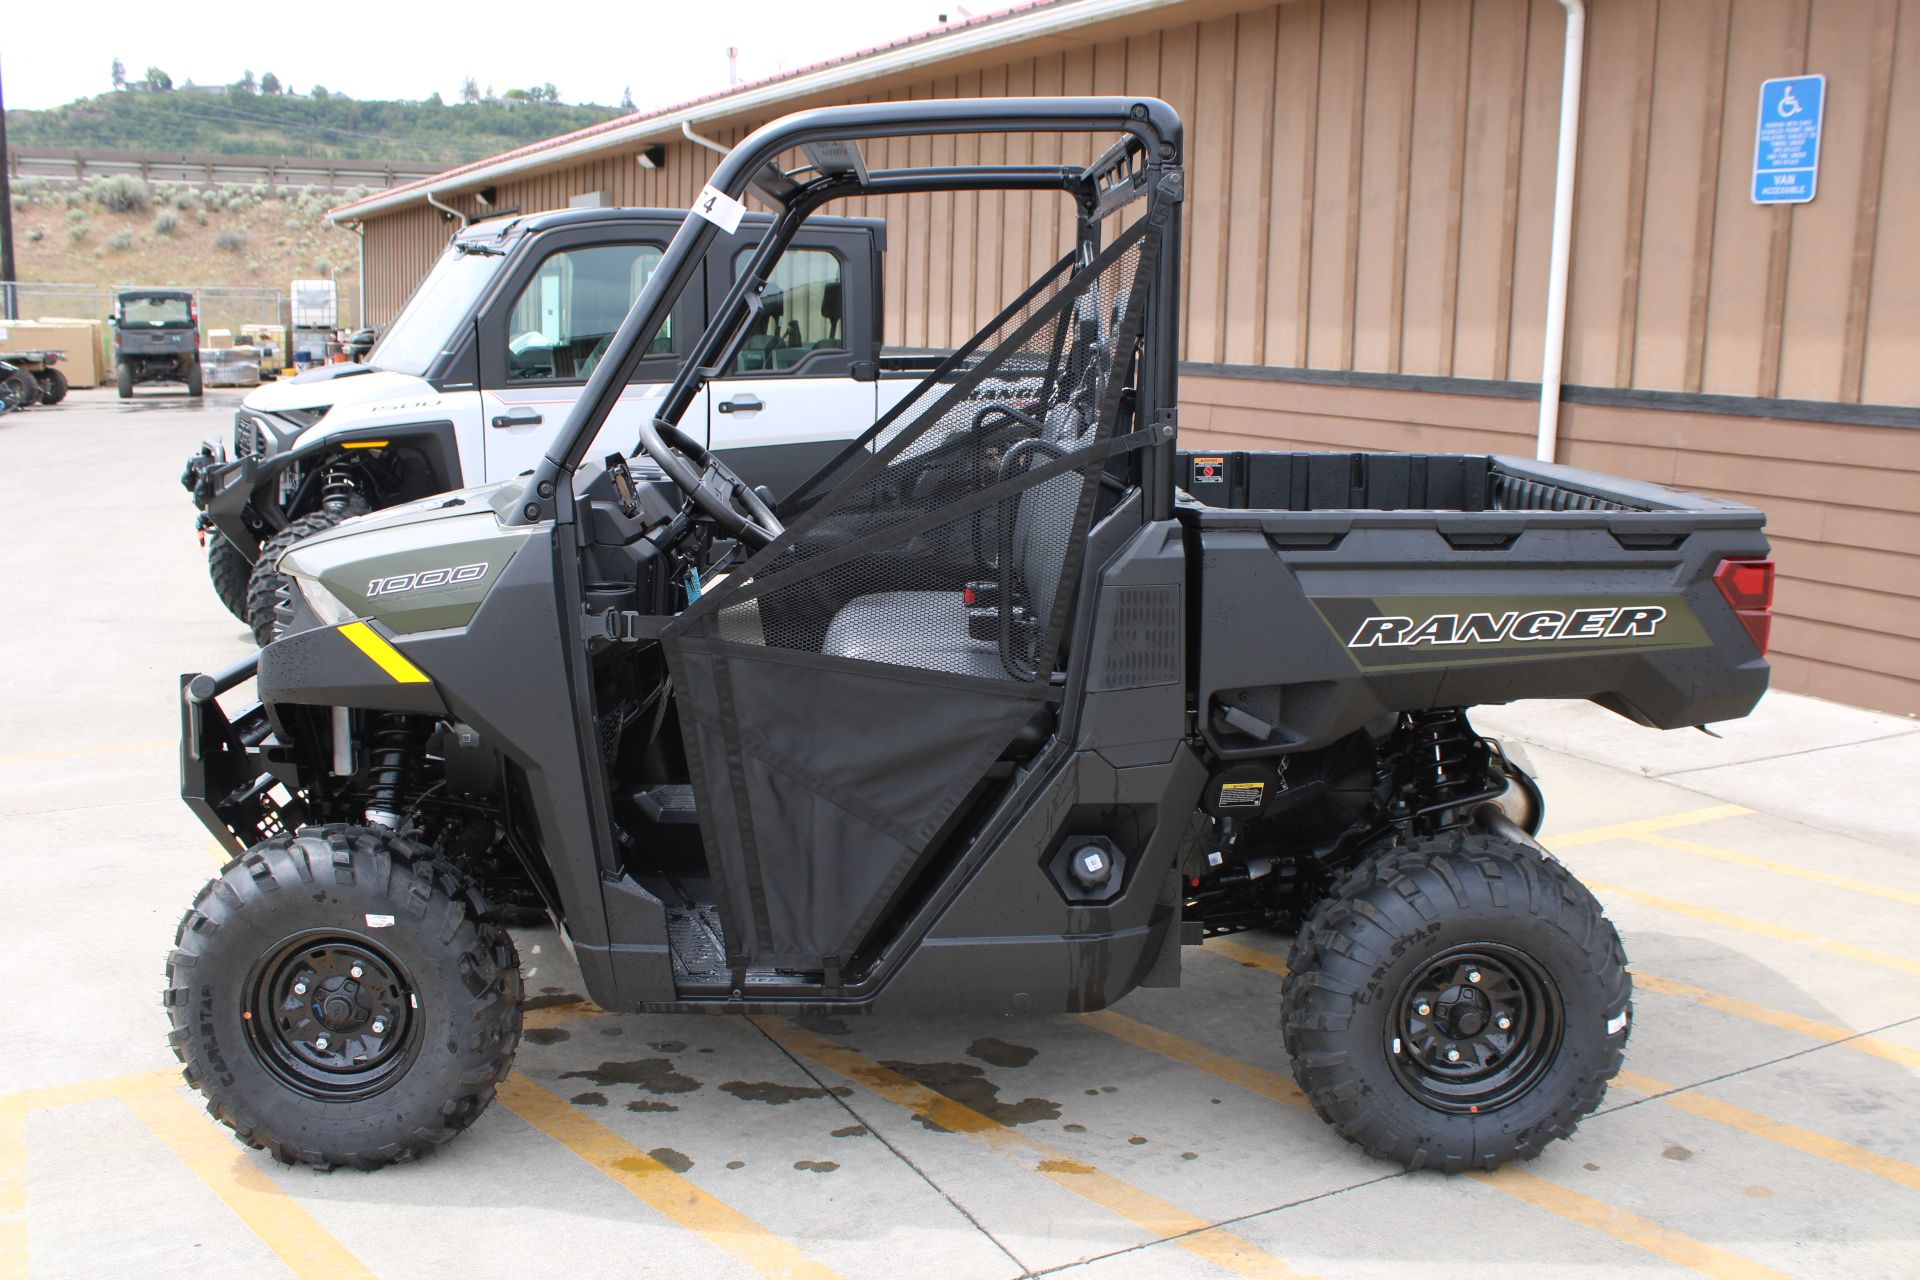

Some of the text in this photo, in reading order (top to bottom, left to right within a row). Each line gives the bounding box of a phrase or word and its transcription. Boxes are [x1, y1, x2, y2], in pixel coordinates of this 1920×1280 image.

[1773, 174, 1796, 186] VAN
[366, 562, 489, 597] 1000
[1347, 605, 1667, 648] RANGER
[199, 984, 235, 1088] CARLSTAR
